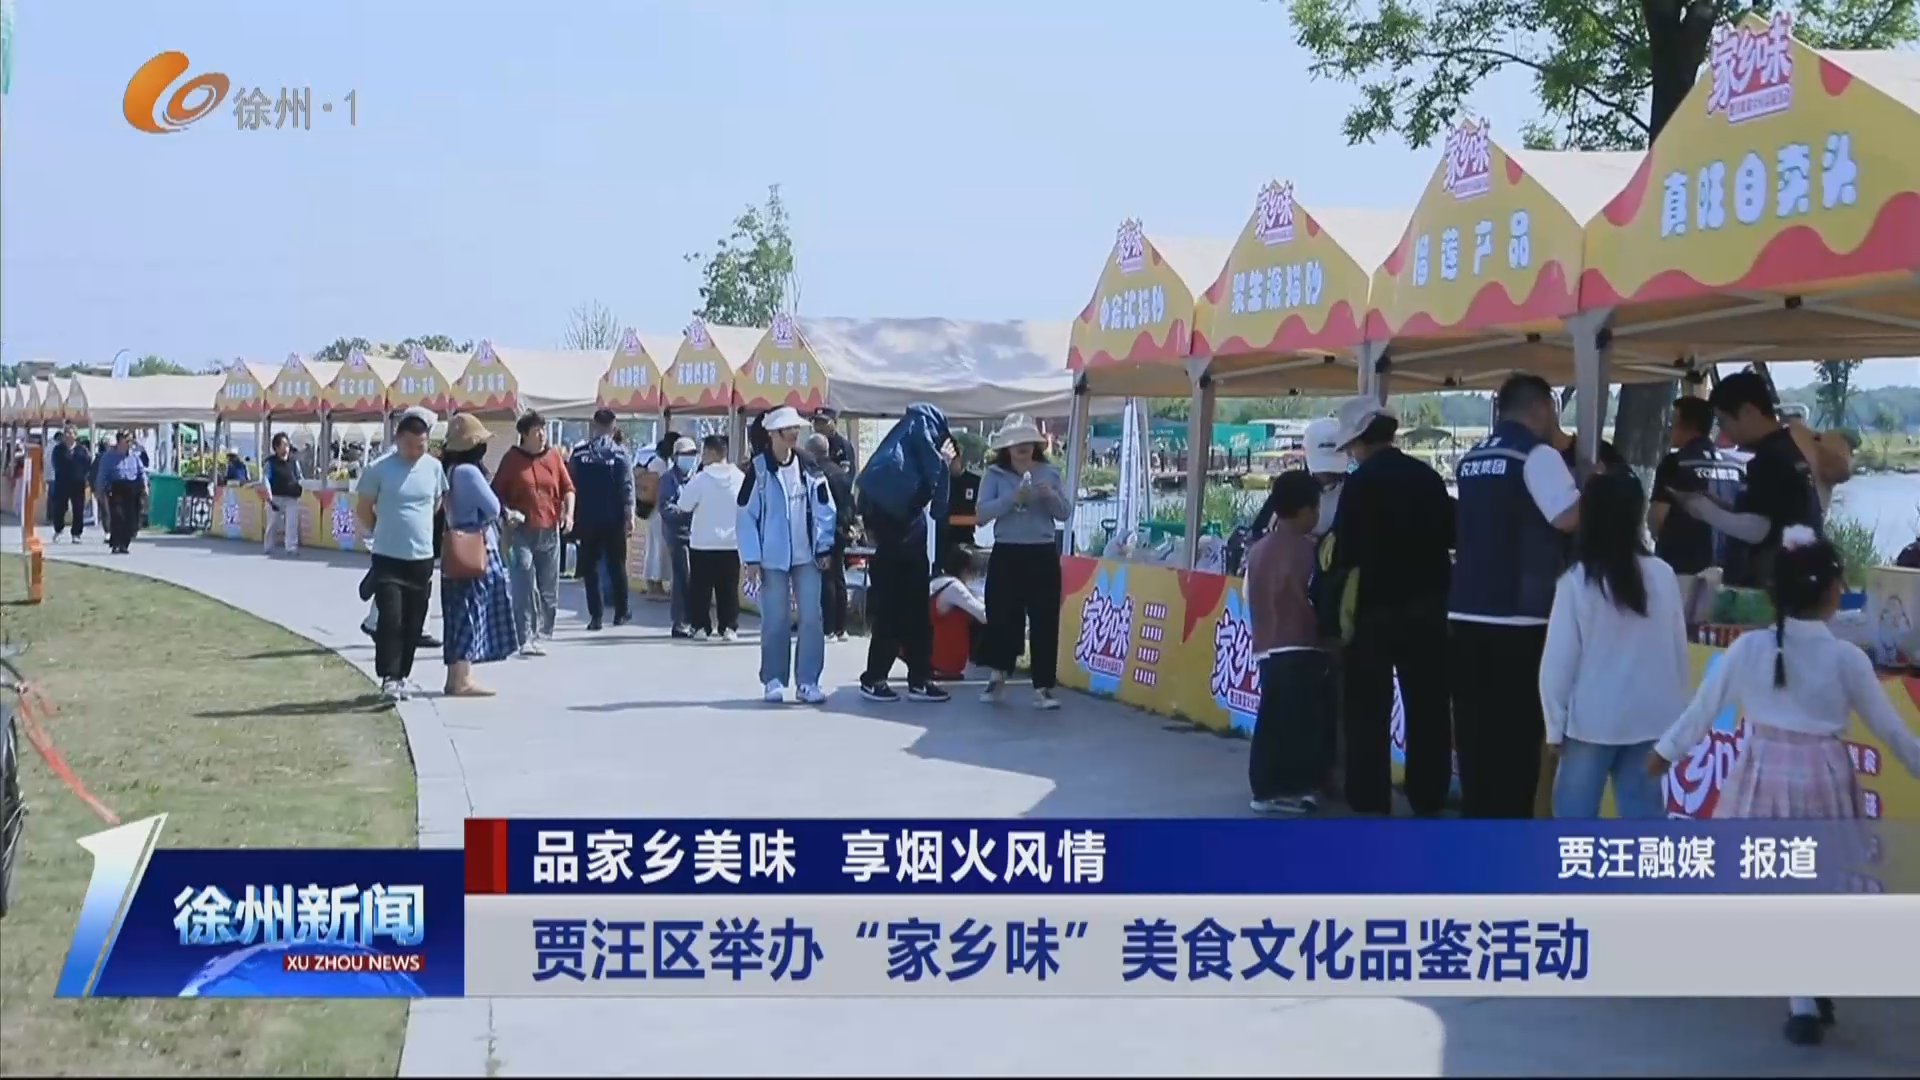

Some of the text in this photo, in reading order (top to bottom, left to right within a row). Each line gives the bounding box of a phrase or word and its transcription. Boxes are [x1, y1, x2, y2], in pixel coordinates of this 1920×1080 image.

[1708, 11, 1793, 114] 家乡味
[1075, 587, 1133, 660] 家乡味
